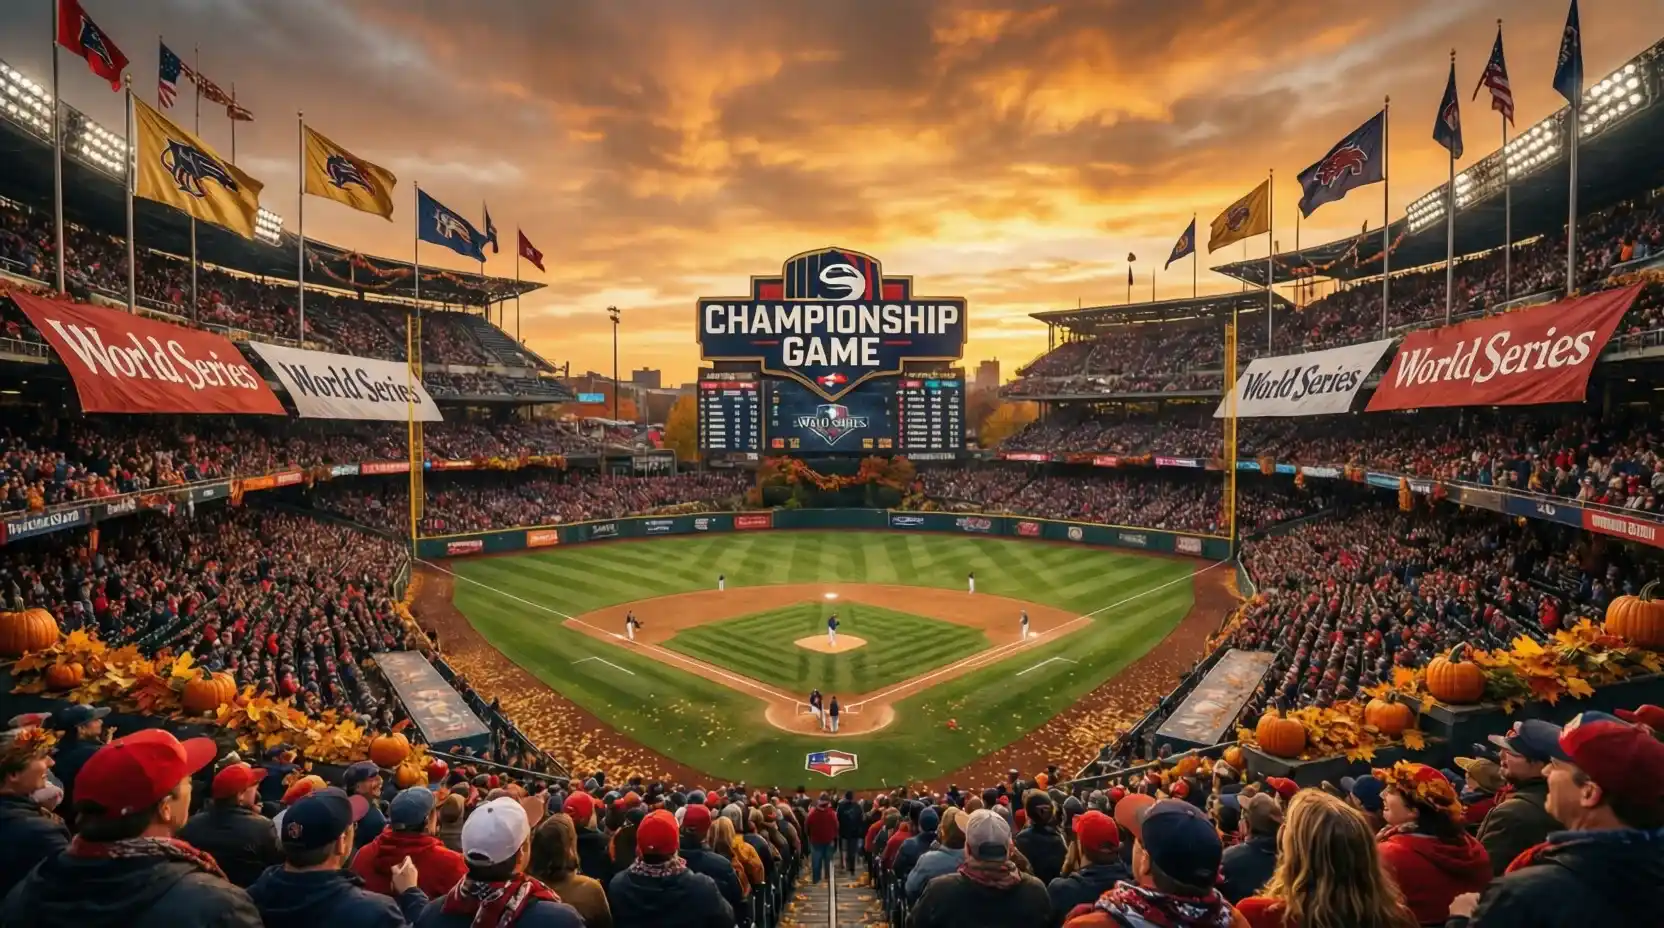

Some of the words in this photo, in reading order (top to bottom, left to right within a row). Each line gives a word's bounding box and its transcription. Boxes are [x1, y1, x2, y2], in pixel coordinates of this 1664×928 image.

[705, 305, 958, 334] CHAMPIONSHIP
[44, 318, 178, 383] World
[167, 338, 259, 392] Series
[782, 337, 880, 367] GAME
[1393, 337, 1482, 389] World
[1471, 326, 1596, 385] Series
[280, 362, 362, 399] World
[355, 367, 421, 404] Series
[1242, 366, 1305, 401] World
[1290, 365, 1361, 402] Series
